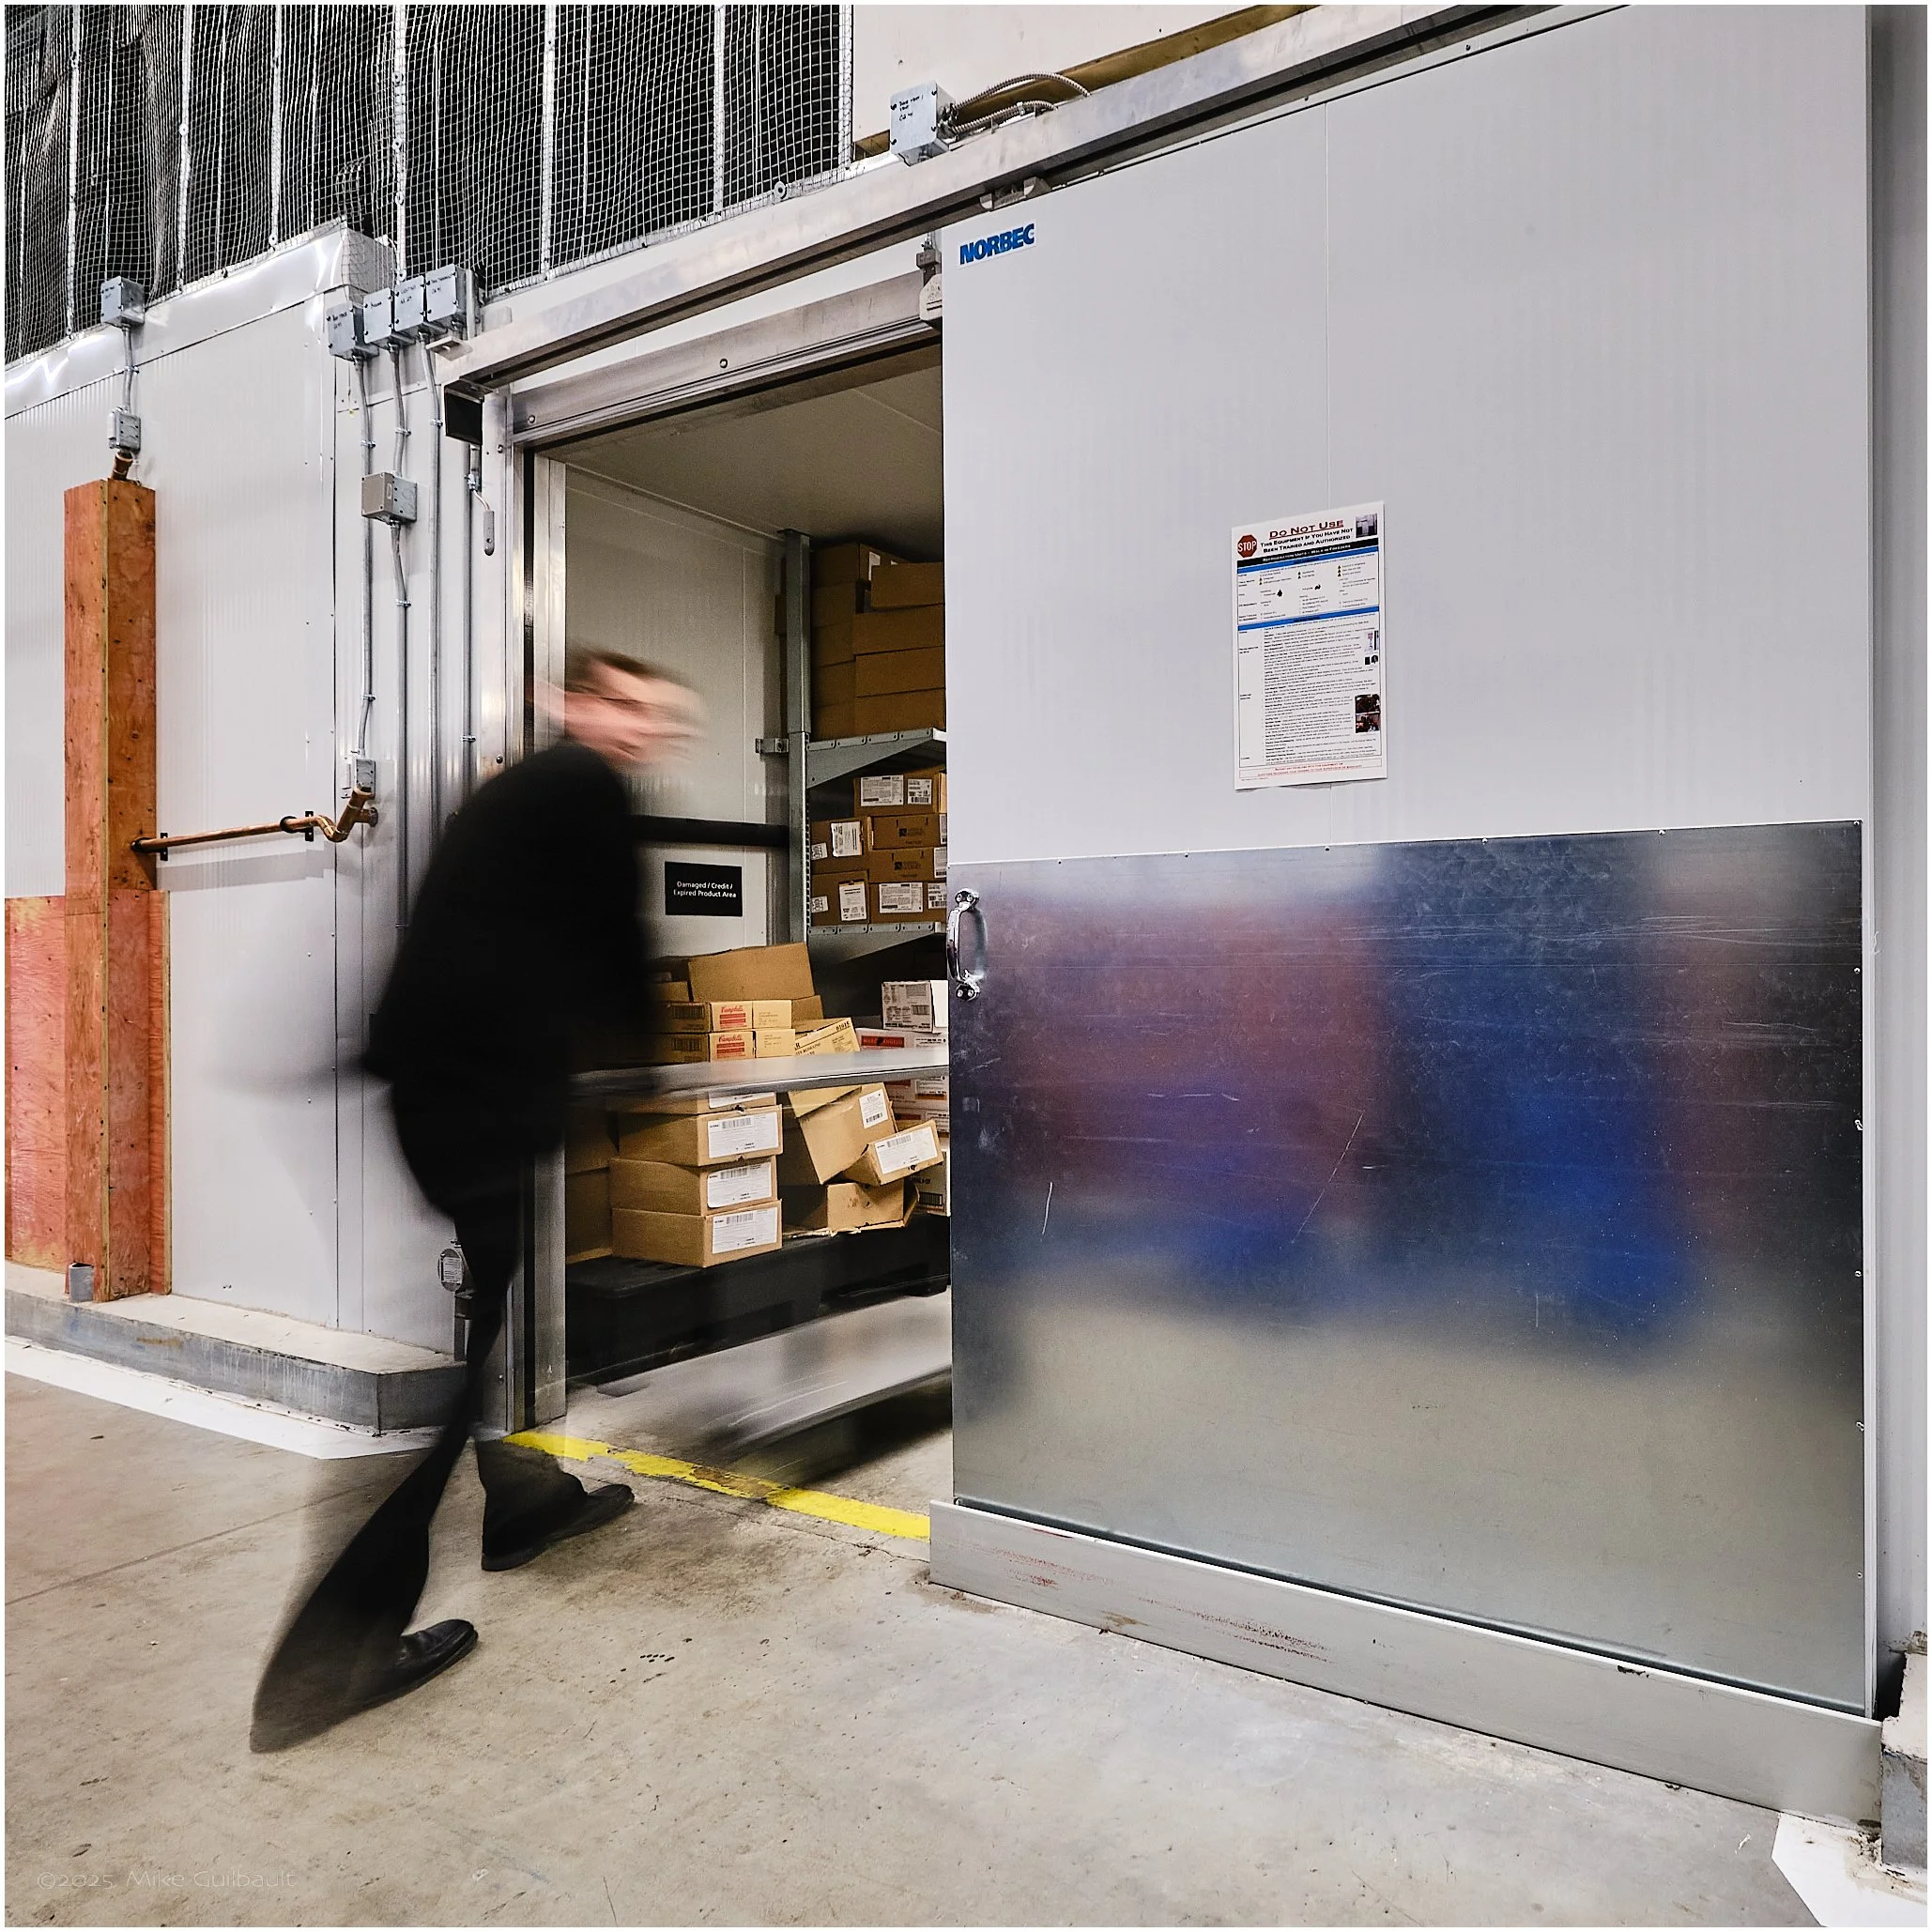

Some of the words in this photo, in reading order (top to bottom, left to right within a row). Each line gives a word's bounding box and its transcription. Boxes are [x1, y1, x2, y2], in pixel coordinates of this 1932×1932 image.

[959, 222, 1035, 265] NORBEC
[1237, 540, 1258, 553] STOP
[676, 881, 707, 890] Damaged
[711, 882, 729, 890] Credit
[673, 889, 697, 897] Expired
